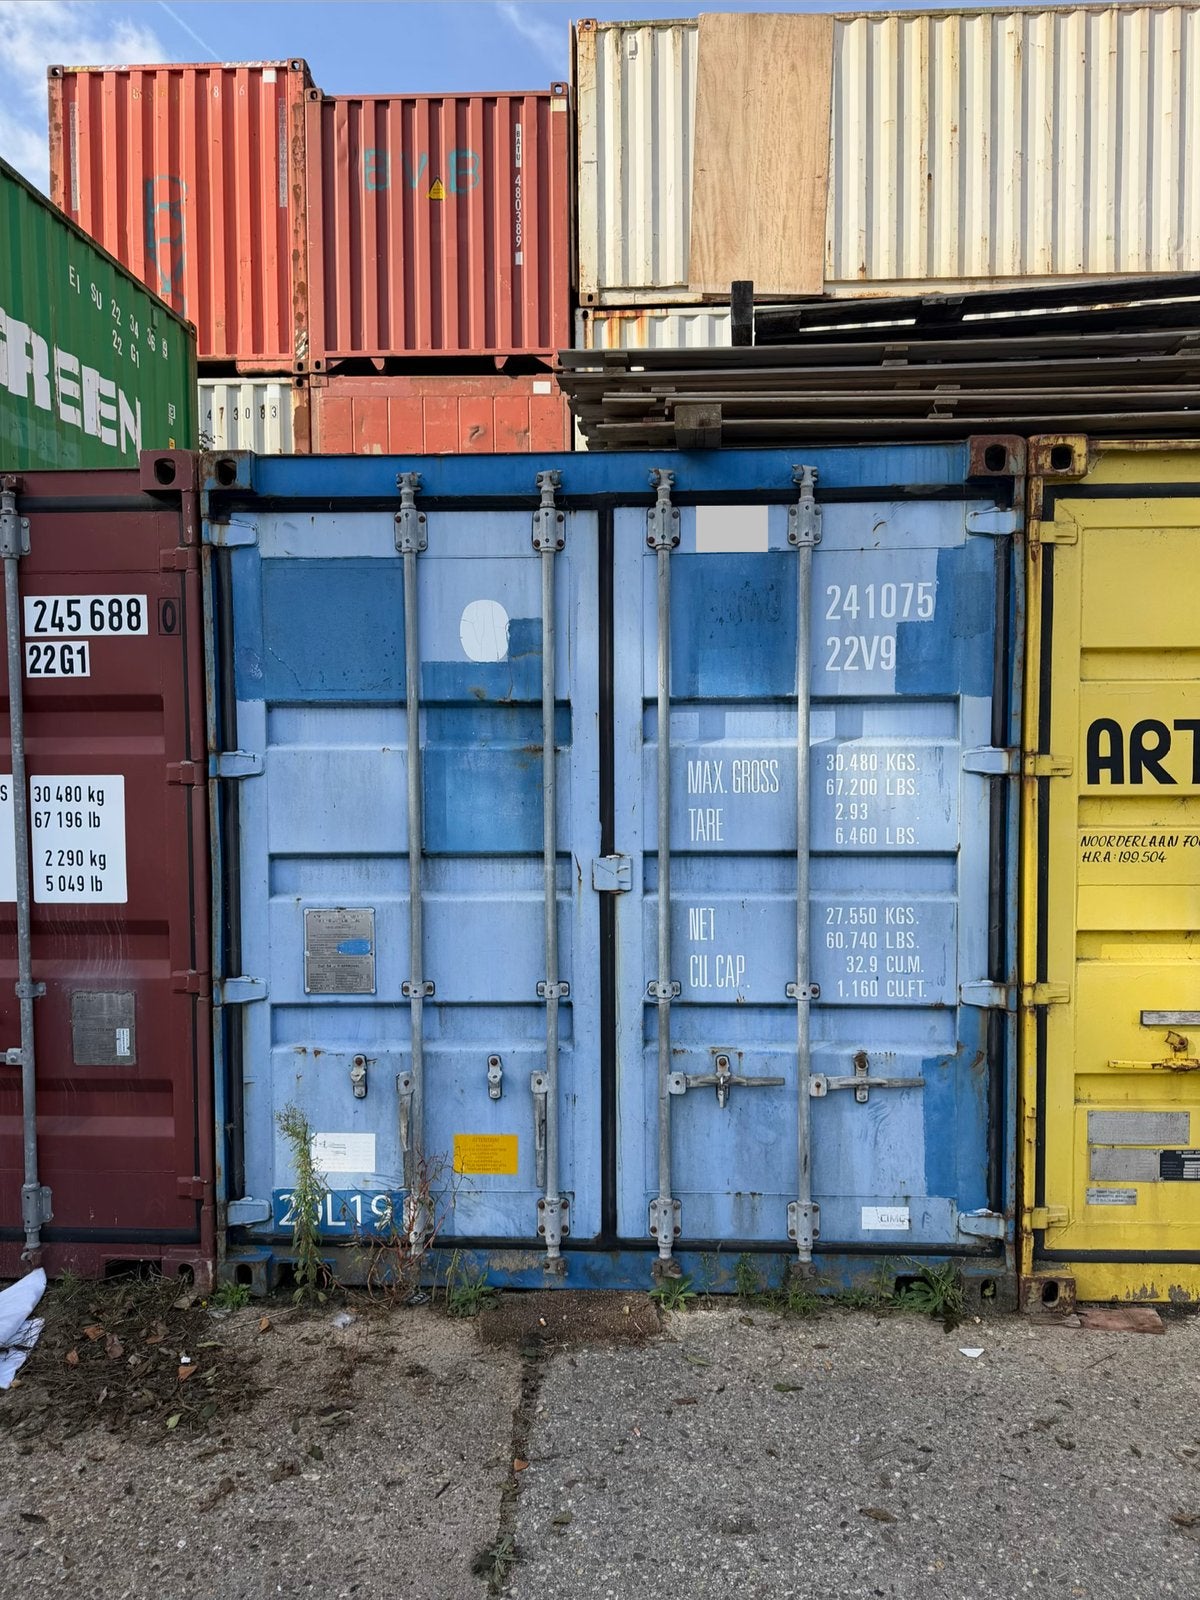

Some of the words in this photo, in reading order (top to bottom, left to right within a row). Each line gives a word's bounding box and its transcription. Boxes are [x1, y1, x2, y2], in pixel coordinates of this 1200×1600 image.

[0, 306, 141, 460] REEN
[825, 583, 934, 620] 241075
[162, 600, 176, 633] 0
[28, 644, 86, 674] 22G1
[825, 636, 896, 671] 22V9
[826, 754, 878, 771] 30.480
[886, 753, 921, 771] KGS.
[687, 760, 728, 794] MAX.
[732, 760, 780, 793] GROSS
[88, 785, 104, 806] kg
[826, 778, 878, 796] 67.200
[886, 778, 920, 795] LBS.
[88, 811, 101, 828] lb
[688, 808, 724, 841] TARE
[835, 827, 877, 844] 6.460
[886, 827, 920, 844] LBS.
[1081, 835, 1179, 847] NOORDERLAAN
[1183, 836, 1200, 847] 70
[90, 850, 106, 870] kg
[91, 876, 103, 892] lb
[689, 908, 715, 940] NET
[826, 908, 876, 925] 27.550
[885, 908, 919, 924] KGS.
[826, 932, 877, 949] 60.740
[886, 932, 919, 949] LBS.
[846, 956, 878, 973] 32.9
[837, 980, 878, 997] 1.160
